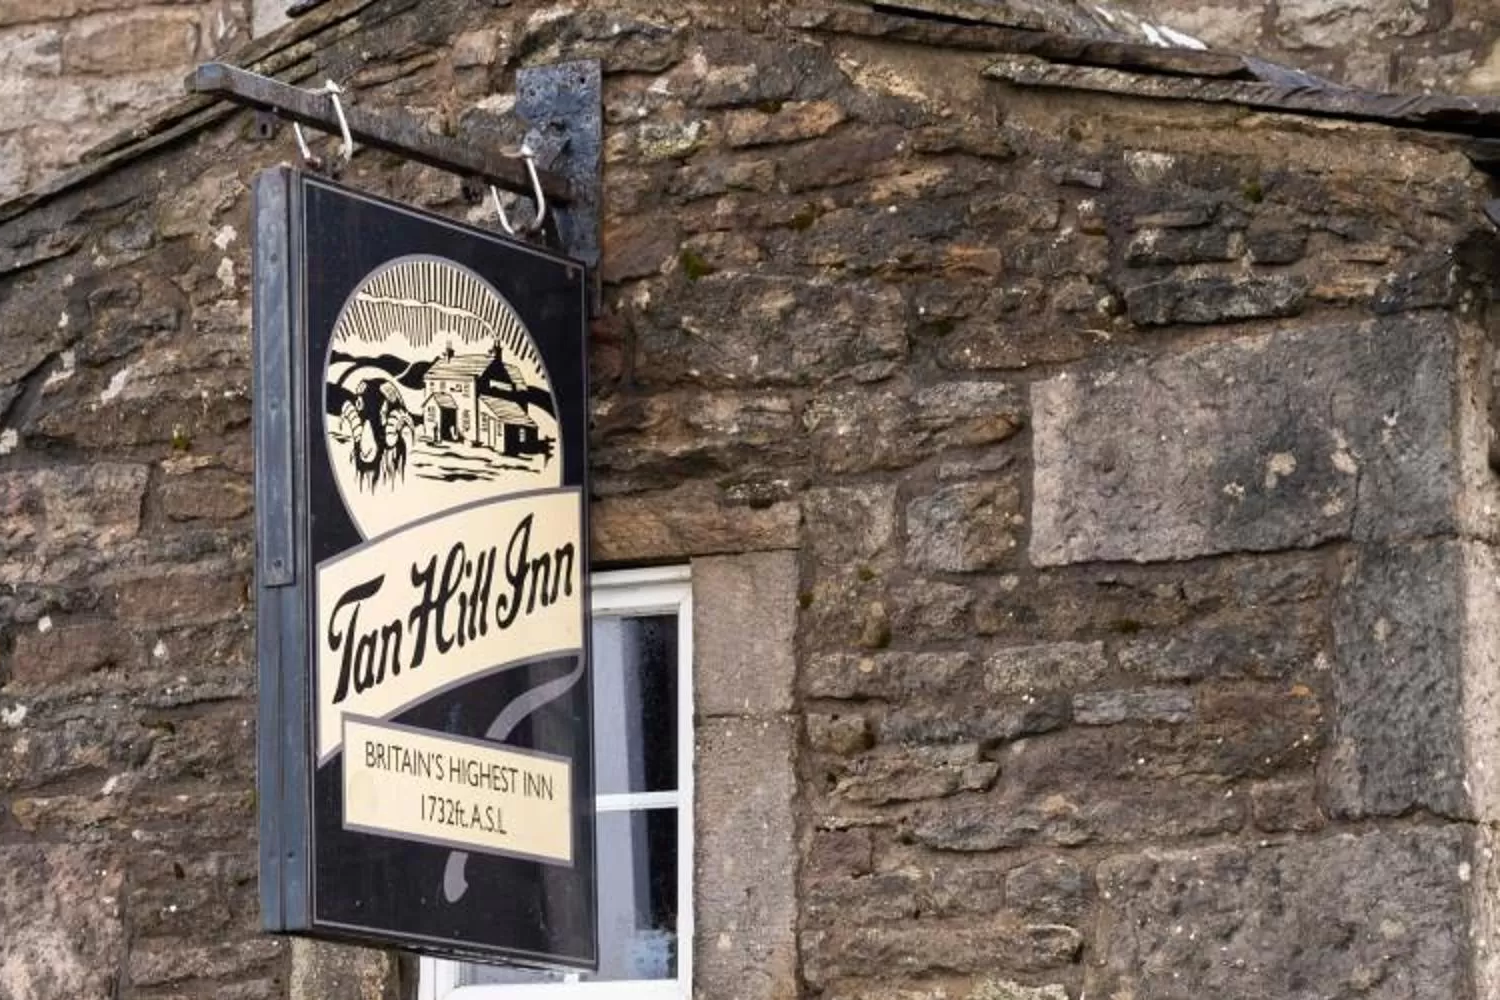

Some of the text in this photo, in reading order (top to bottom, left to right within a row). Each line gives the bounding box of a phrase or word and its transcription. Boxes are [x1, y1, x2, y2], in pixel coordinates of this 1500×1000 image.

[328, 512, 575, 704] Tan Hill Inn
[365, 741, 553, 800] BRITAIN'S HIGHEST INN
